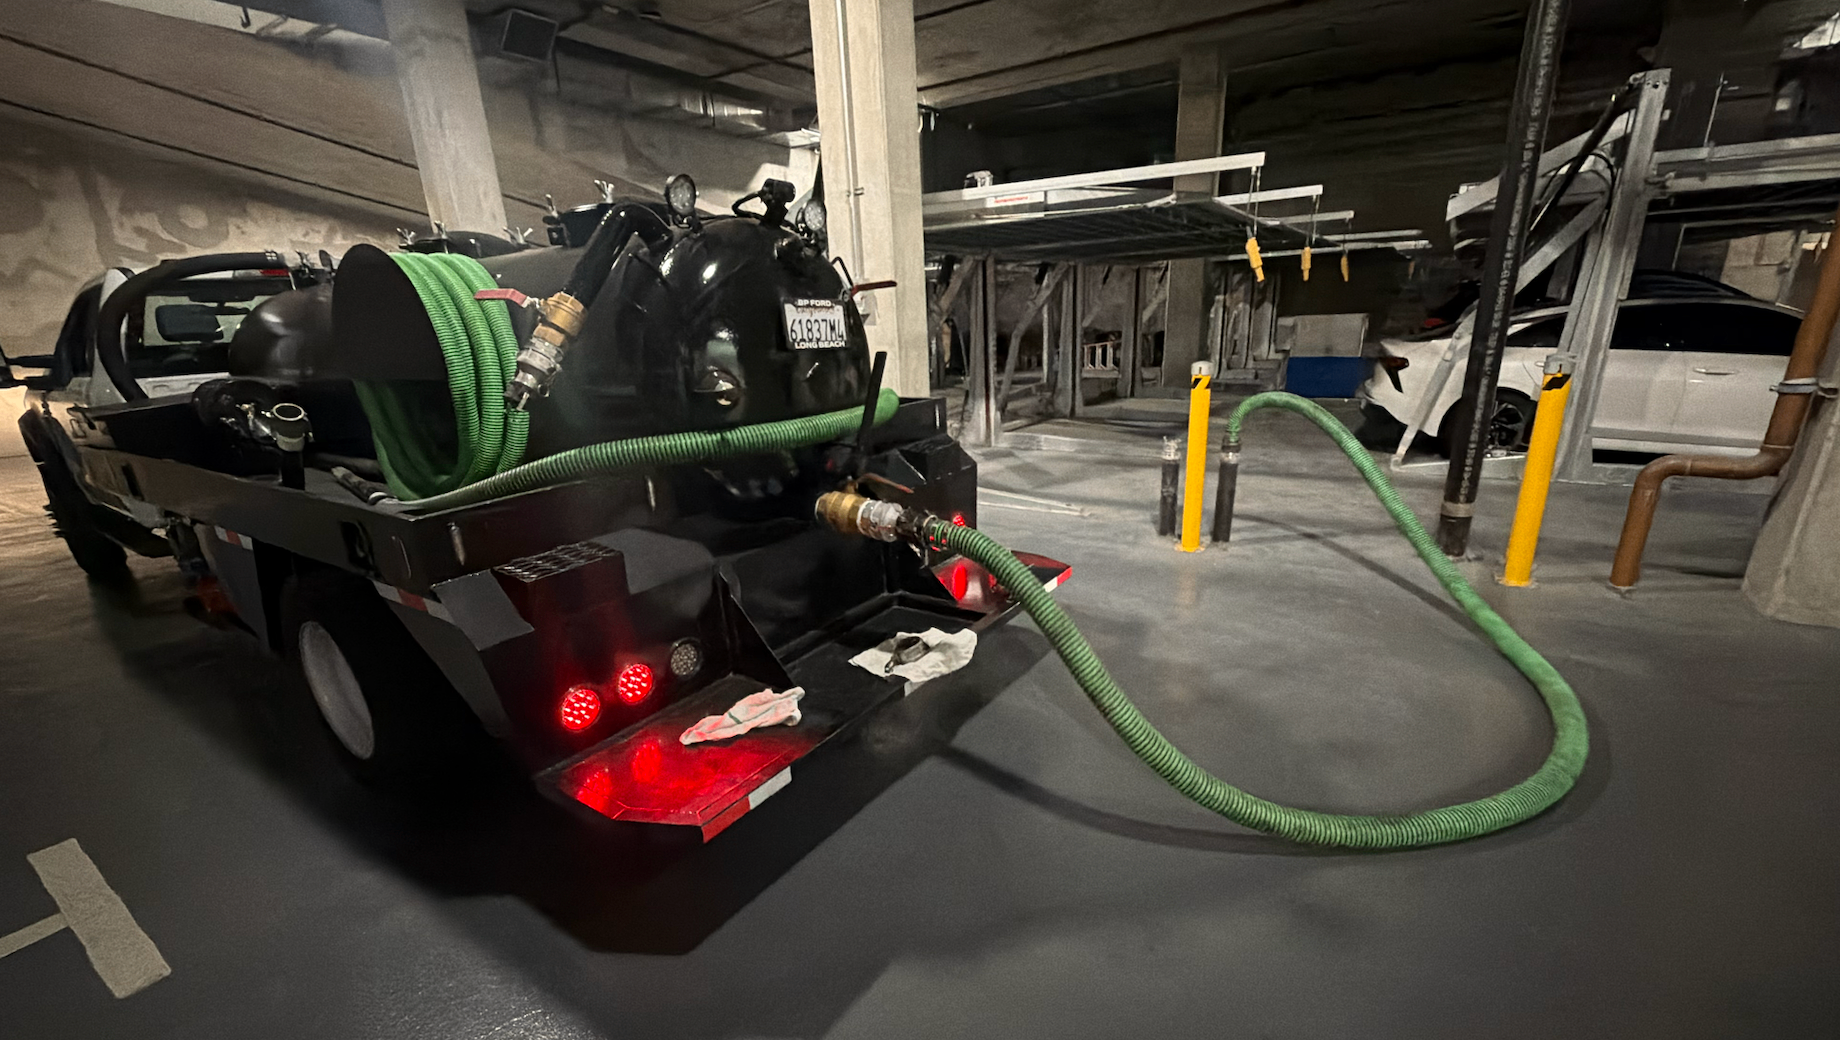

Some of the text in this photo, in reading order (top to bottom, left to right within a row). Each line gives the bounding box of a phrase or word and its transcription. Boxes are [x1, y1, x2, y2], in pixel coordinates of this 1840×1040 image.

[810, 299, 832, 307] FORD
[794, 340, 846, 349] LONG BEACH
